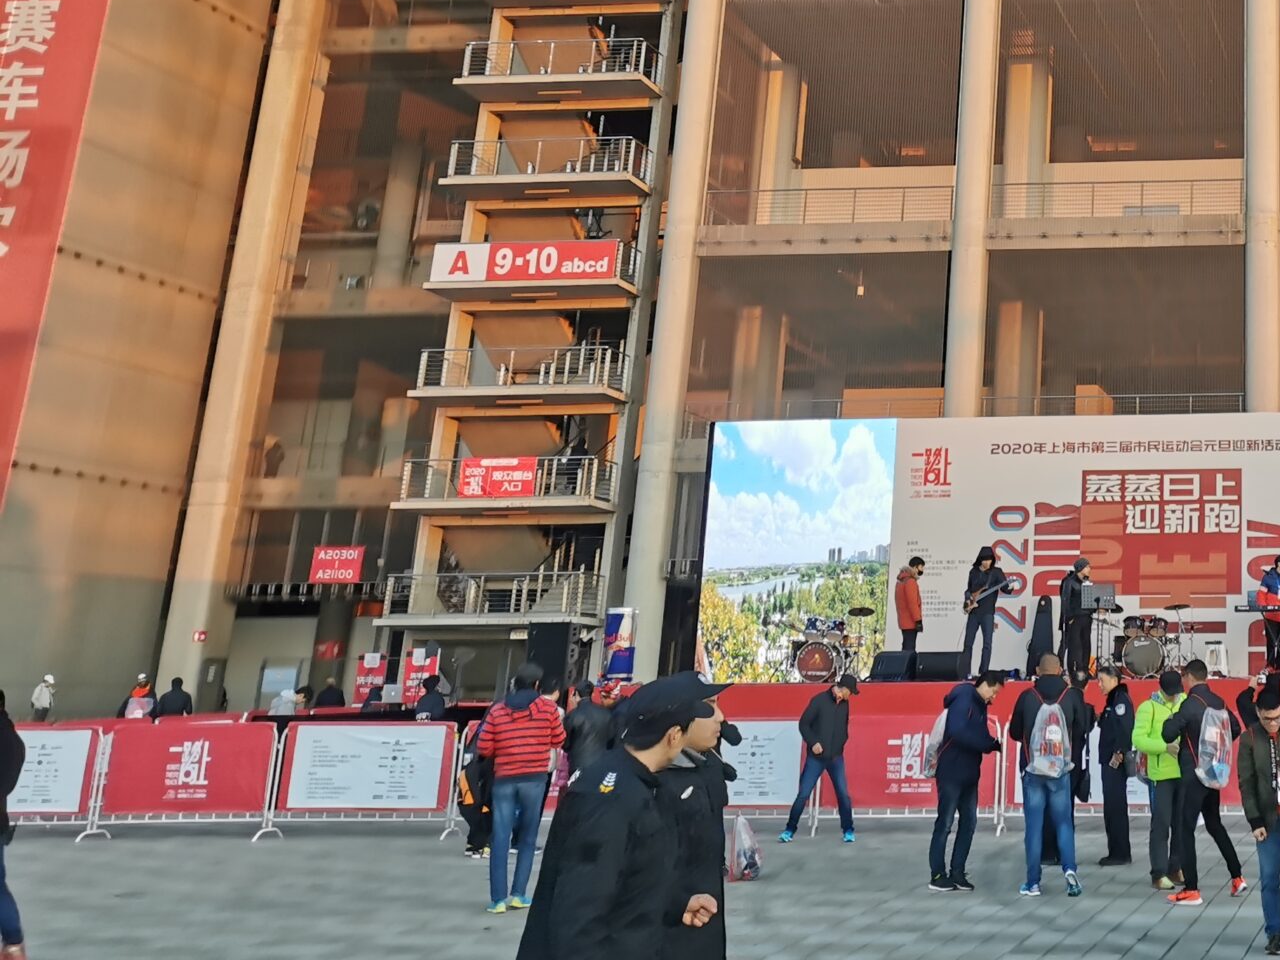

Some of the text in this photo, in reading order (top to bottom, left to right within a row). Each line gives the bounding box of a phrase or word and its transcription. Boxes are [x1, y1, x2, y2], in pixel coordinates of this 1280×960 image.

[448, 250, 469, 275] A
[561, 256, 609, 274] abcd
[500, 481, 522, 492] 入口
[1085, 473, 1238, 502] 蒸蒸日上
[1125, 503, 1240, 535] 迎新跑
[318, 550, 358, 560] A20301
[316, 569, 354, 579] A21100
